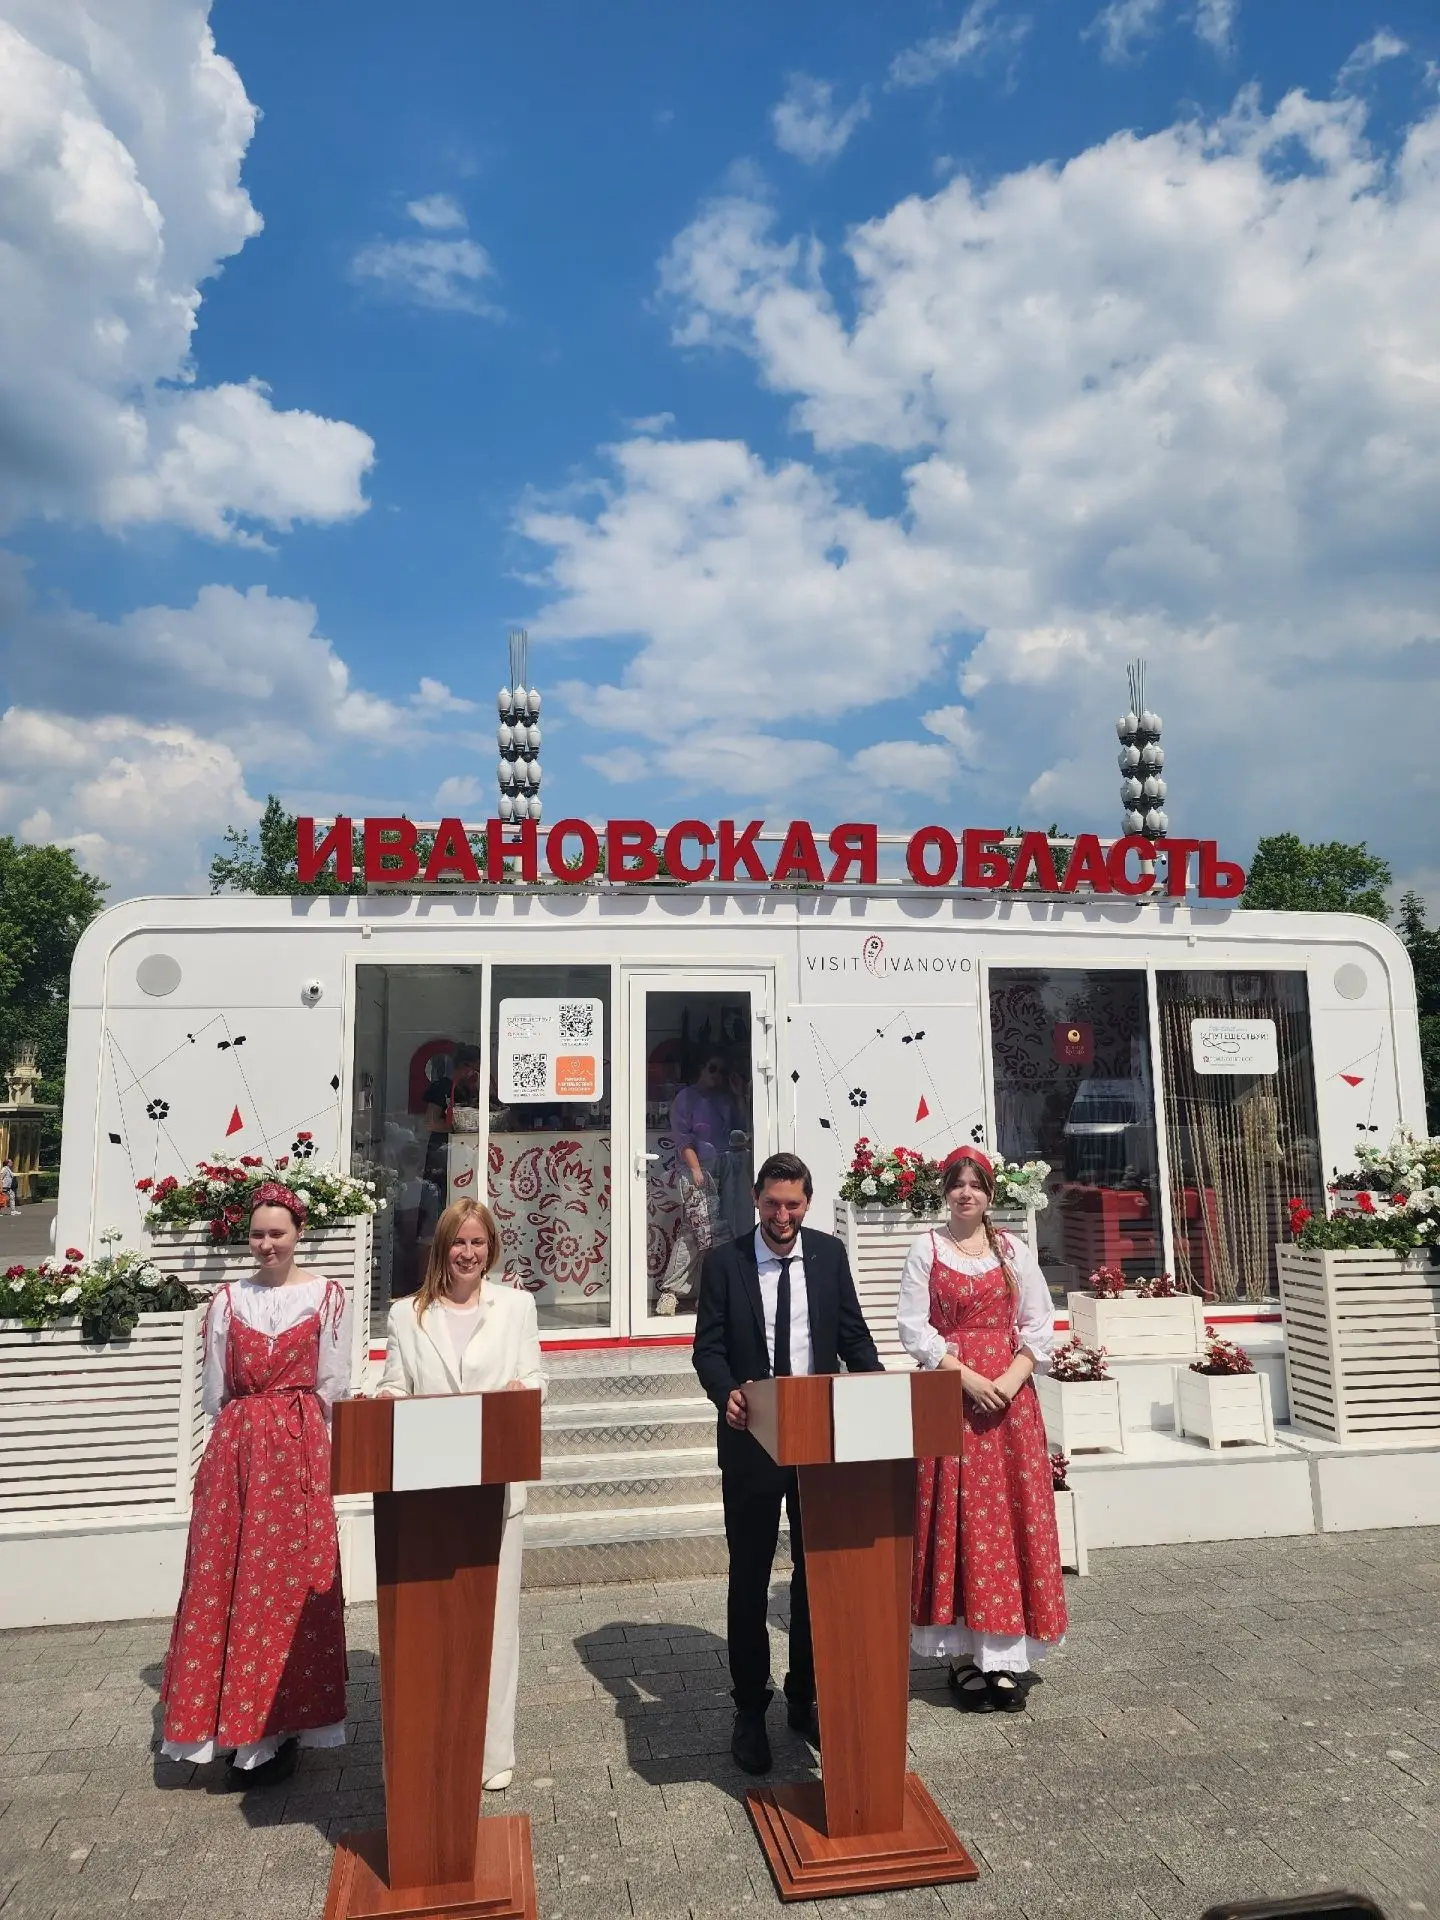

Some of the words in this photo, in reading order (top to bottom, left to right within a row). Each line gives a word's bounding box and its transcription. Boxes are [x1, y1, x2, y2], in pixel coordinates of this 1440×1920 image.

[296, 816, 877, 884] ИВАНОВСКАЯ
[906, 825, 1246, 899] ОБЛАСТЬ
[806, 956, 860, 971] VISIT
[884, 957, 972, 972] IVANOVO
